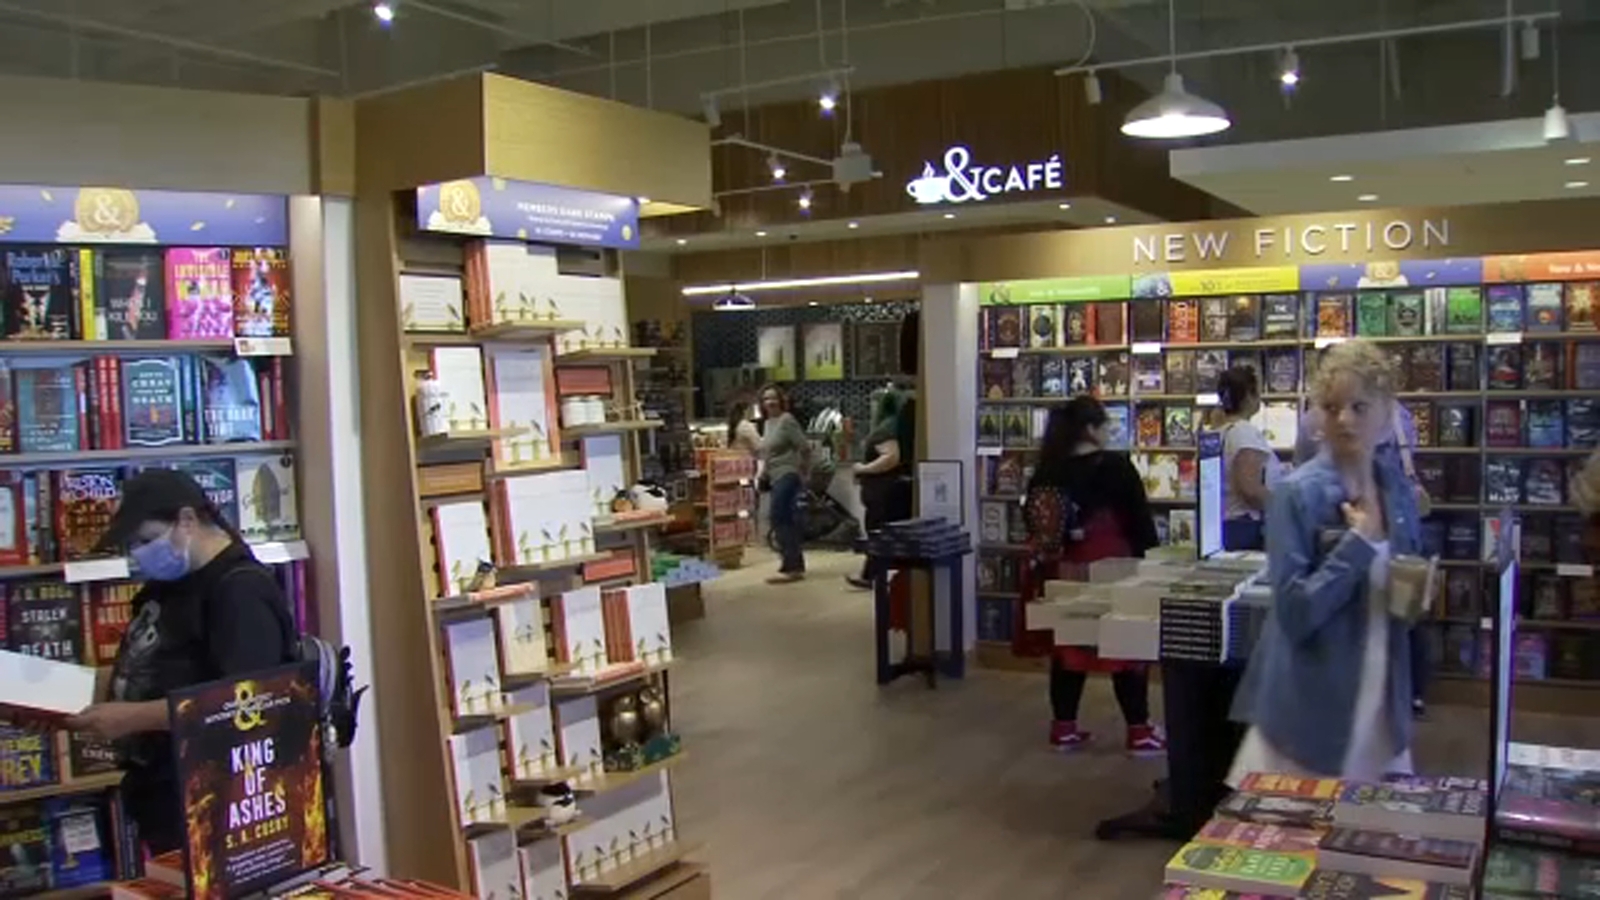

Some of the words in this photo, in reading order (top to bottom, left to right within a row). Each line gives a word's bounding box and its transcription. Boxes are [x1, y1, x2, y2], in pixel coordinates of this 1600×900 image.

[982, 154, 1062, 193] CAFÉ
[1133, 231, 1230, 263] NEW
[1254, 218, 1449, 257] FICTION
[20, 640, 74, 659] DEATH
[231, 737, 275, 773] KING
[243, 766, 267, 796] OF
[229, 788, 286, 829] ASHES
[225, 834, 239, 849] S.
[255, 815, 290, 838] COSBY
